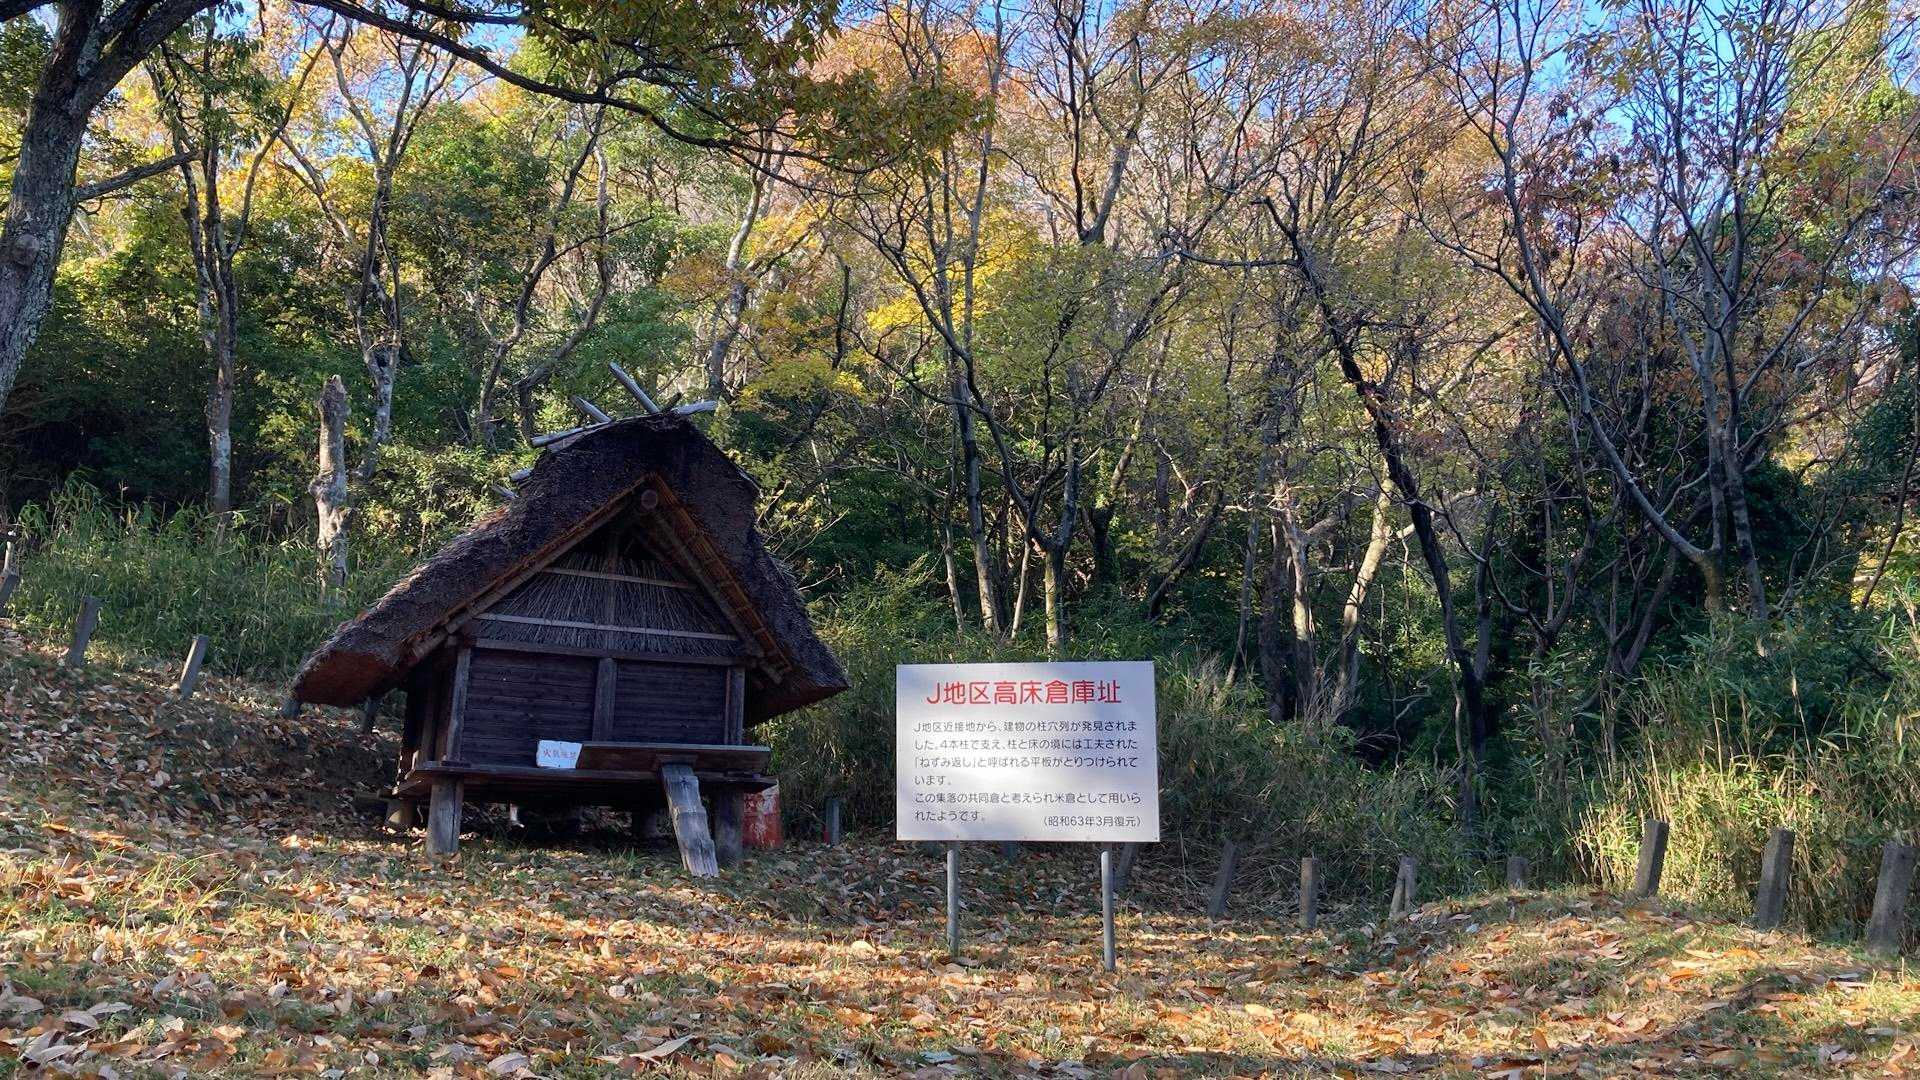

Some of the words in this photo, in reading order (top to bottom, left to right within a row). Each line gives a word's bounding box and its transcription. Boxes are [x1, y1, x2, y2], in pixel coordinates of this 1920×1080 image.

[926, 679, 1122, 705] J地区高床倉庫址
[914, 775, 952, 786] います。
[915, 810, 985, 822] れたようです。
